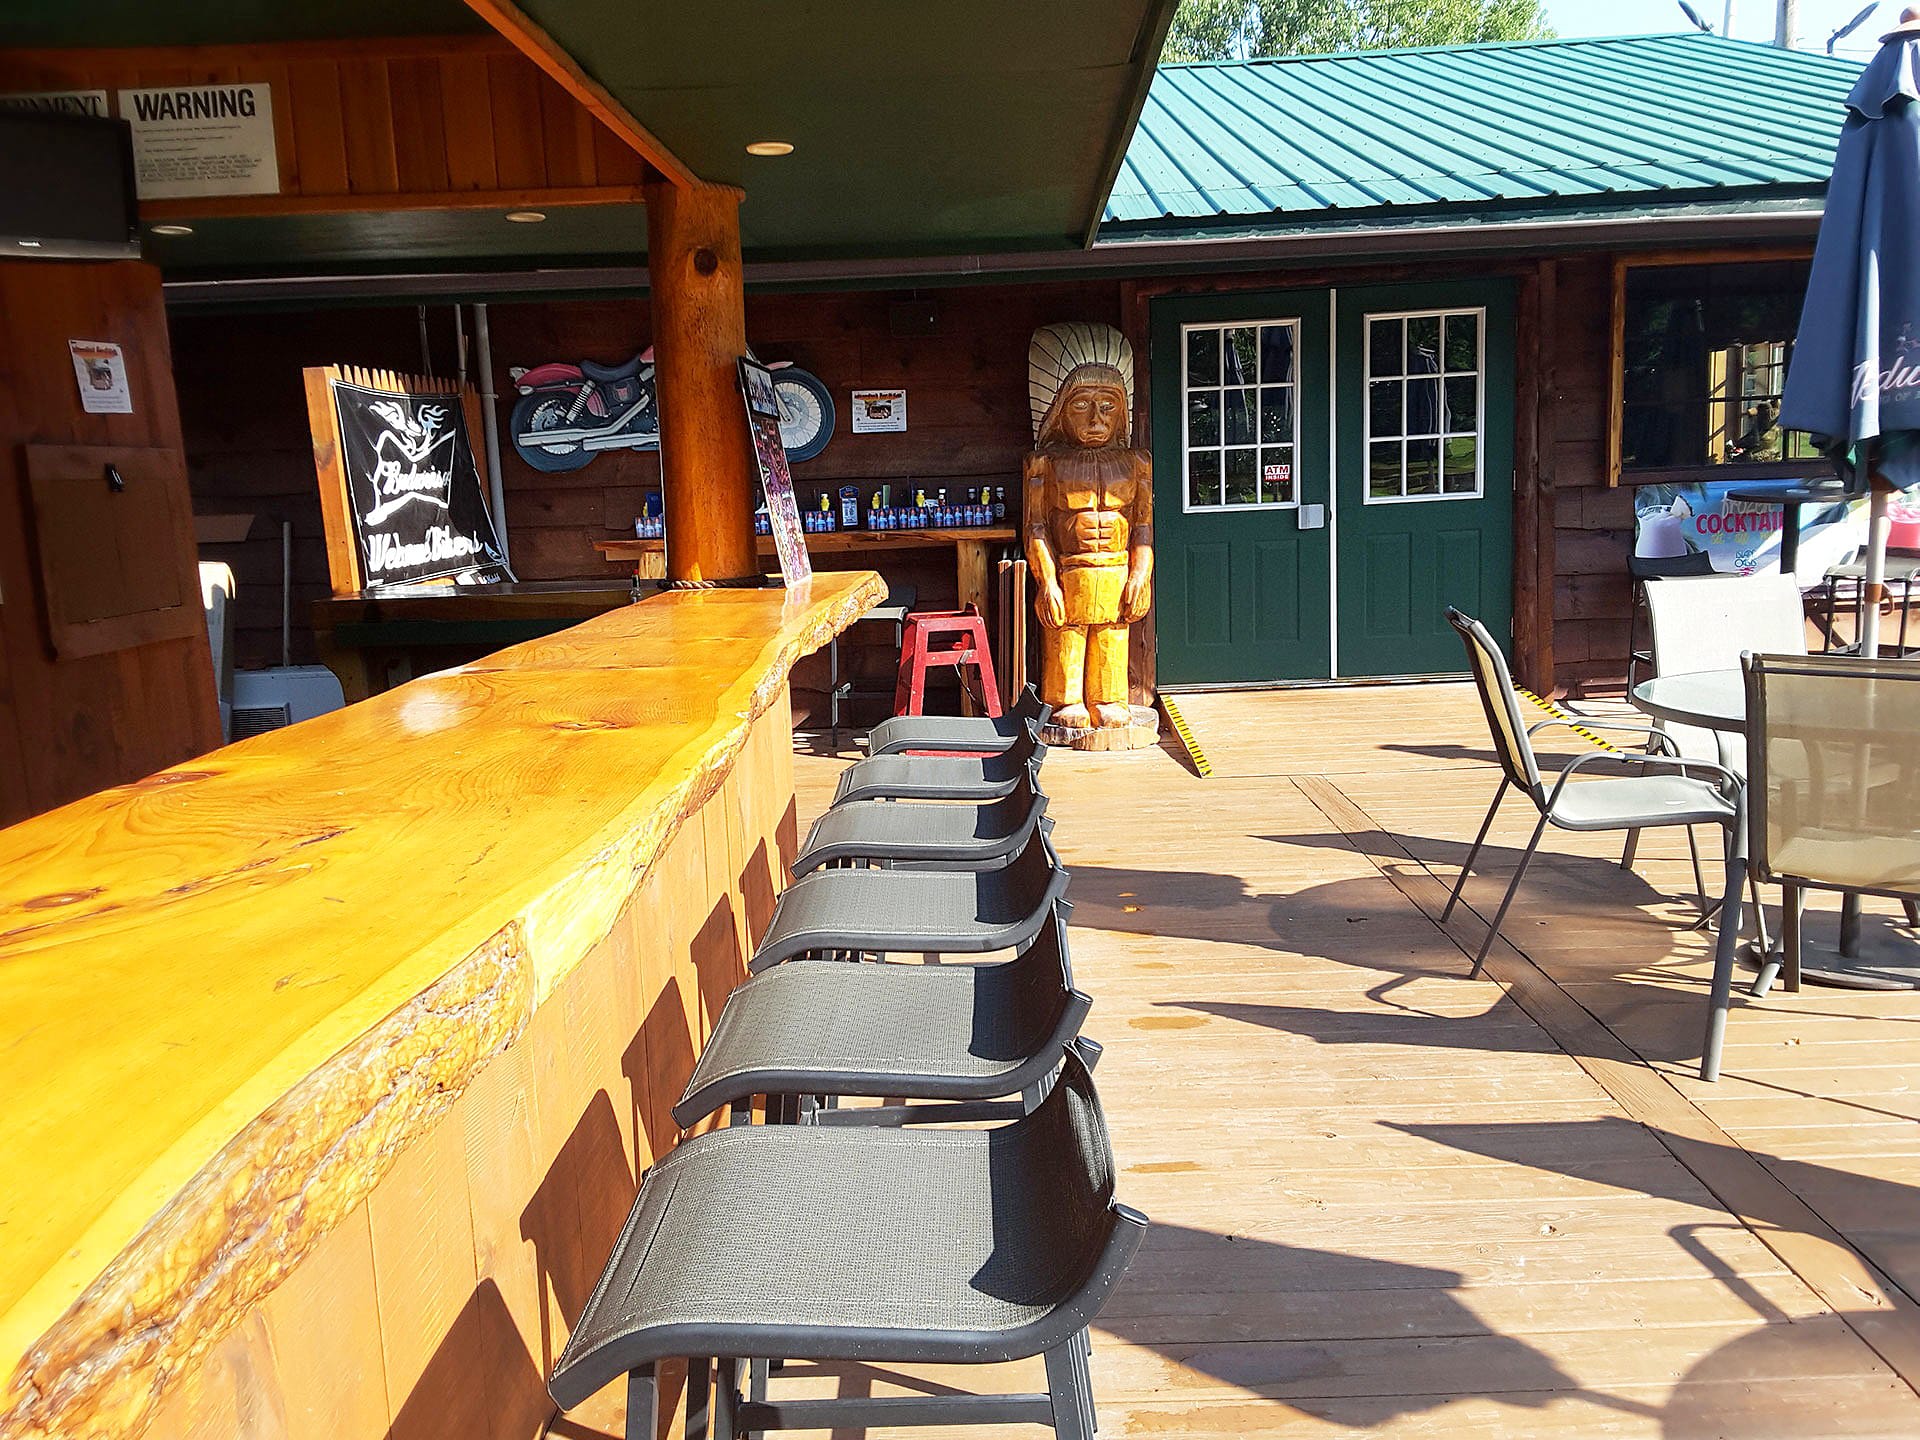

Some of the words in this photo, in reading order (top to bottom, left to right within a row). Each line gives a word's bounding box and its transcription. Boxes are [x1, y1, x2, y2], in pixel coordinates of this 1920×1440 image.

[133, 88, 256, 121] WARNING
[1266, 466, 1289, 474] ATM
[429, 525, 483, 562] Bikers
